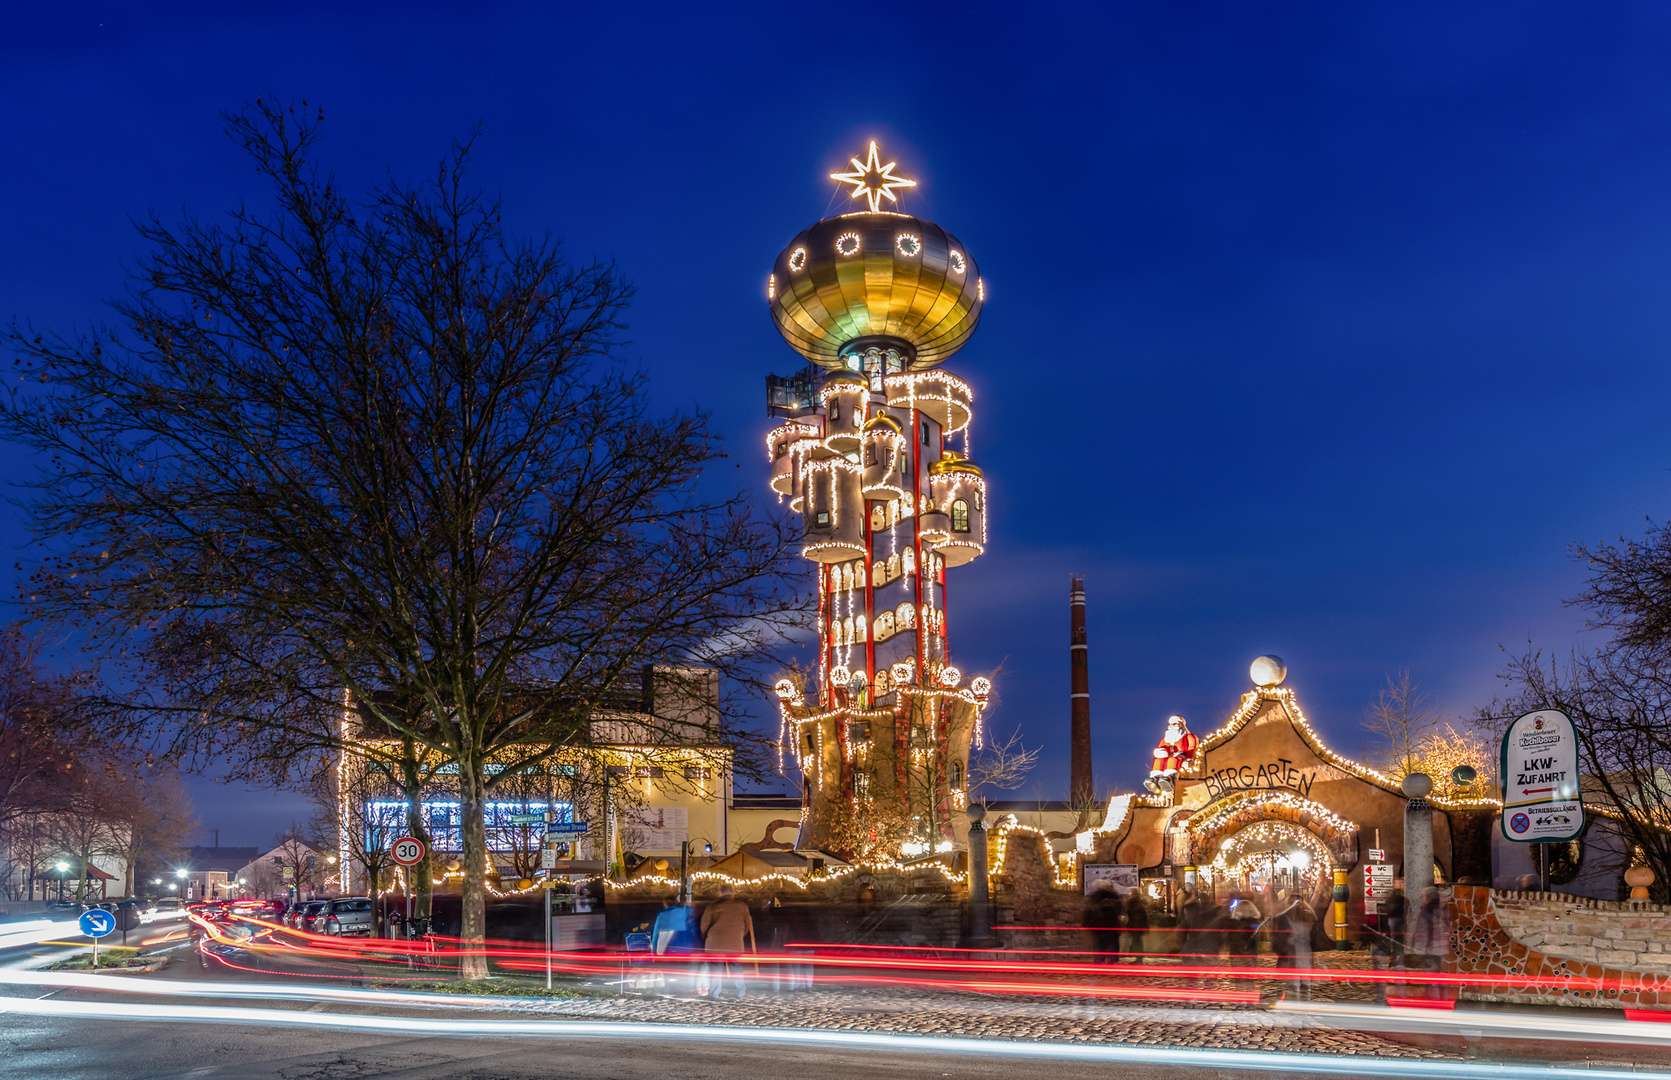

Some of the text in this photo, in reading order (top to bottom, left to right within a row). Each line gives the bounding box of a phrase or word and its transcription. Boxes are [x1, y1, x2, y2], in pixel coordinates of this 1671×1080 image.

[1519, 735, 1560, 747] Kuchlbauer
[1524, 757, 1557, 771] LKW-
[1517, 772, 1566, 785] ZUFAHRT
[1528, 805, 1577, 815] BETRIEBSGELÄNDE
[571, 823, 587, 831] Strasse
[398, 844, 417, 857] 30
